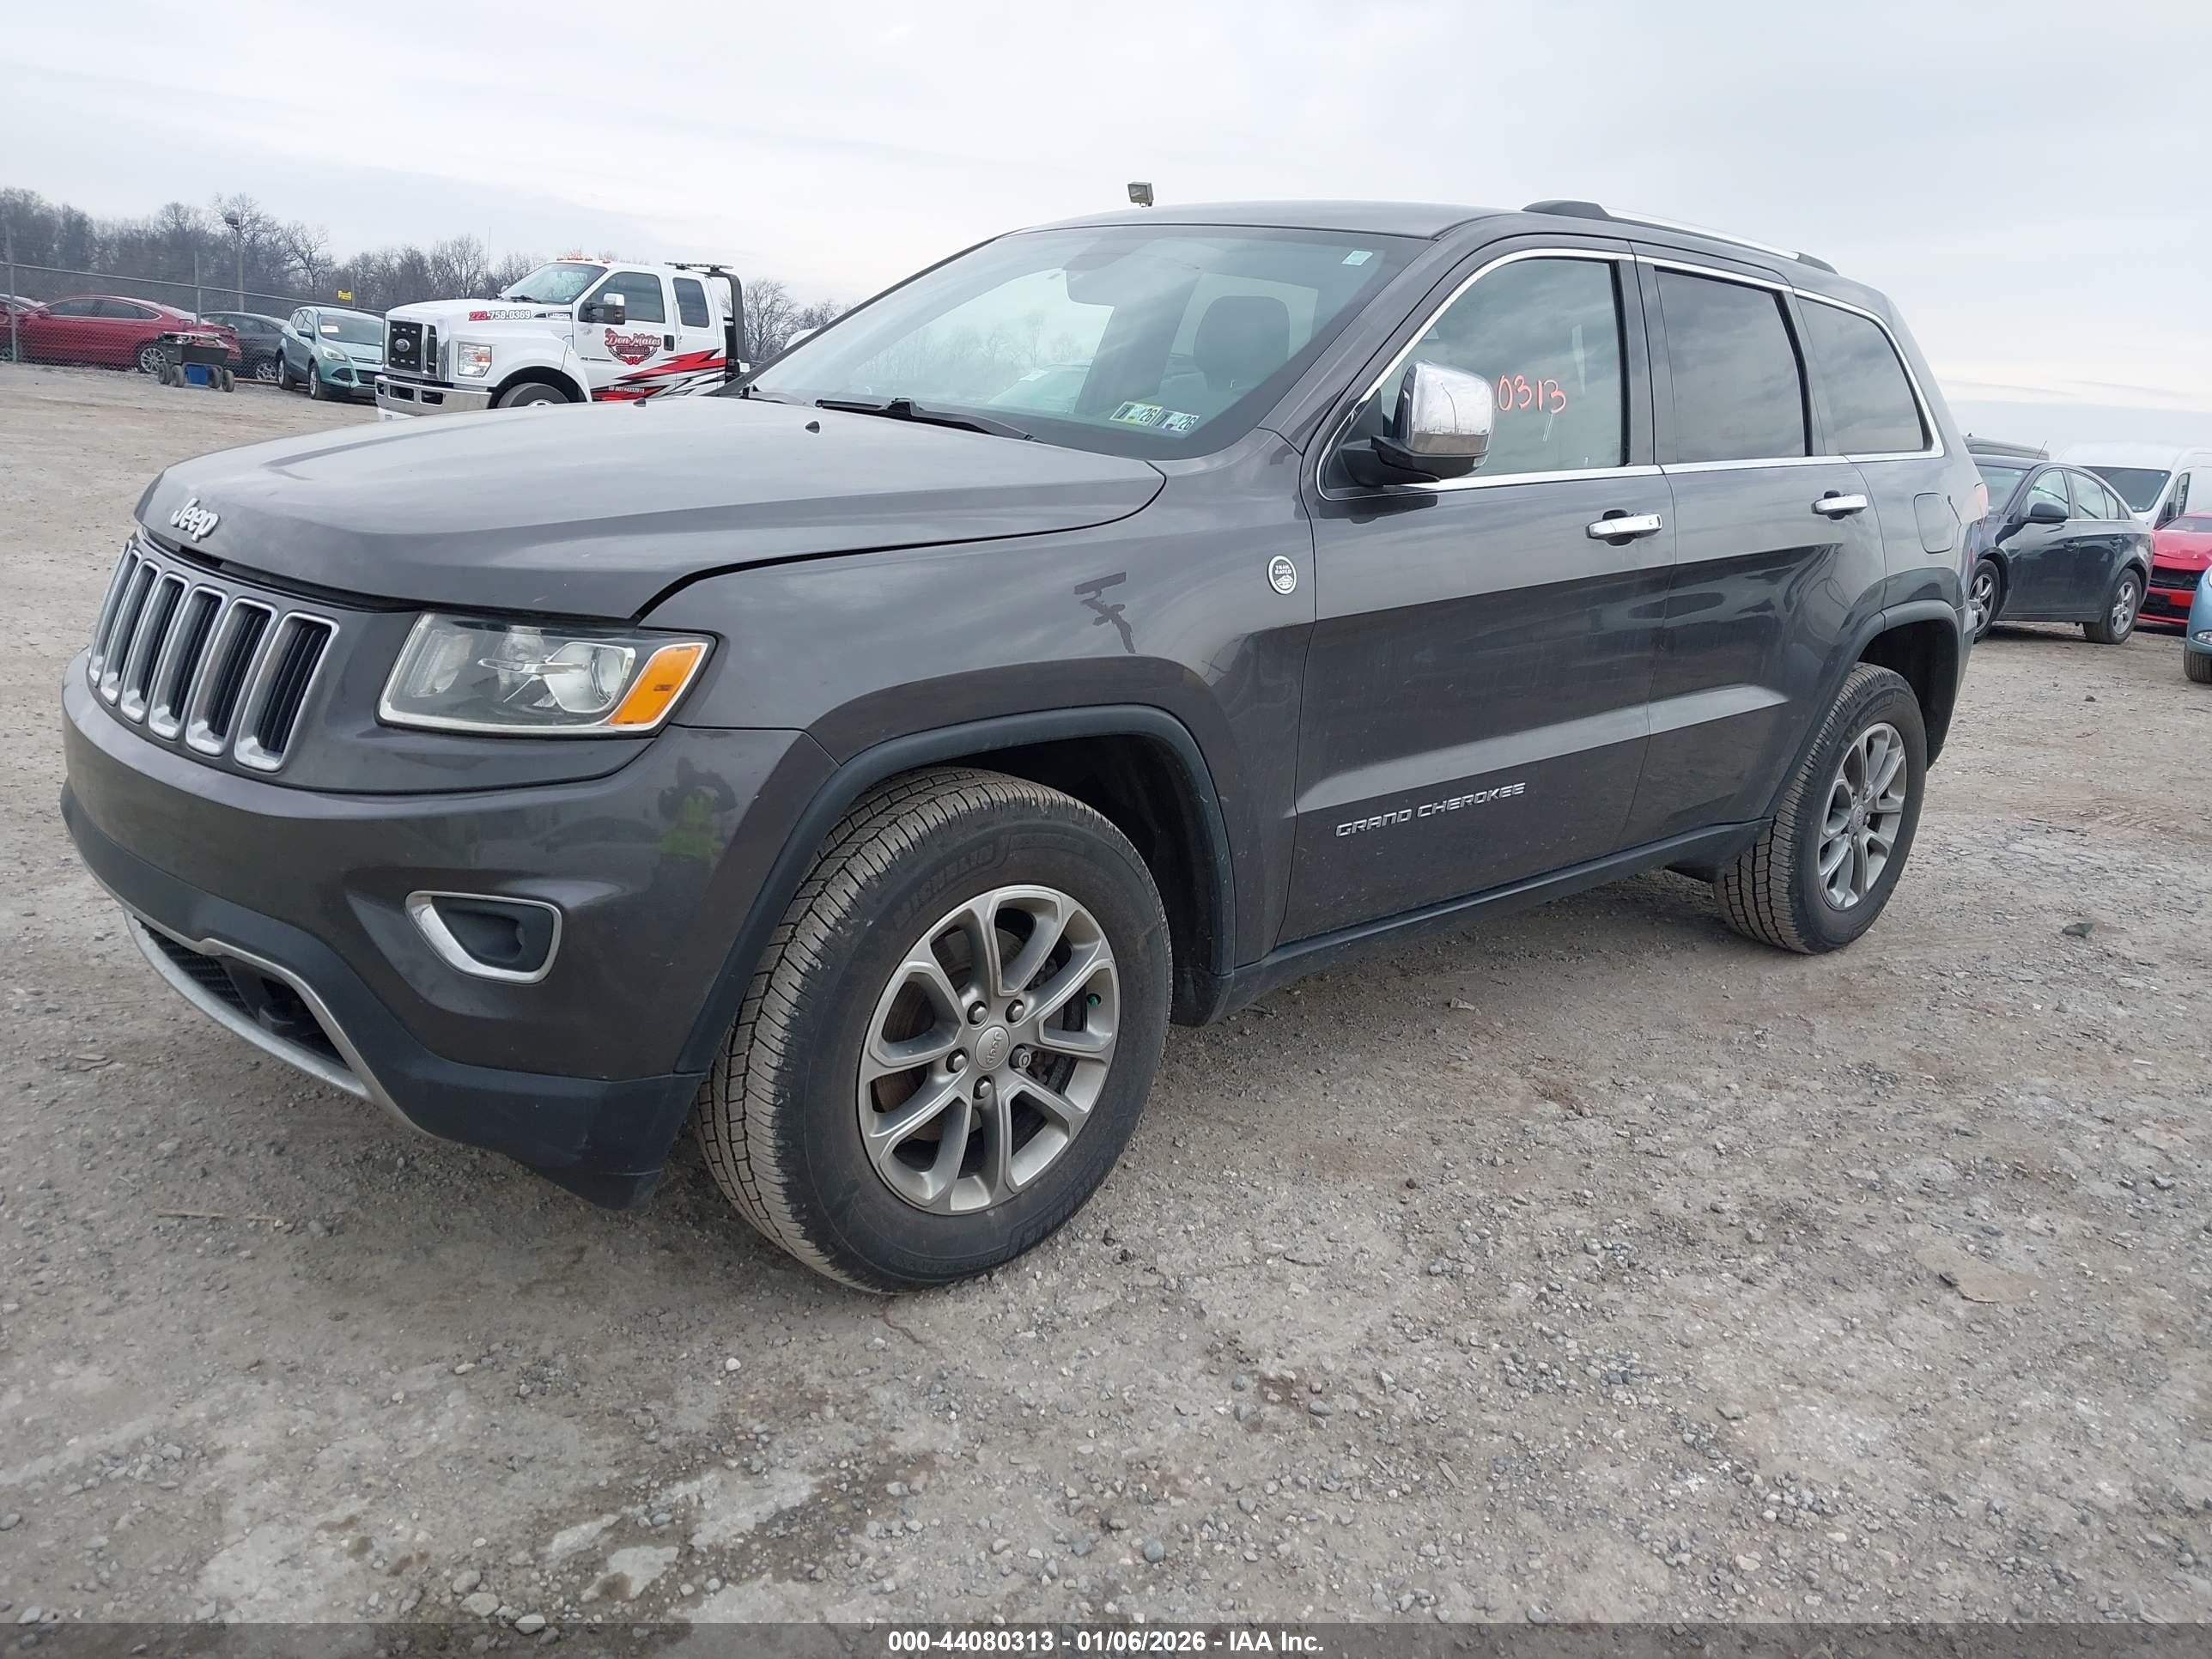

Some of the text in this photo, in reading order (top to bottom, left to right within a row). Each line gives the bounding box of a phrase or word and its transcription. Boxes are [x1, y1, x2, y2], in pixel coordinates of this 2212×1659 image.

[468, 310, 531, 321] 223.758.0369
[606, 332, 631, 346] Don
[1498, 374, 1566, 414] 0313
[170, 497, 220, 542] Jeep
[1335, 782, 1526, 838] GRAND CHEROKEE
